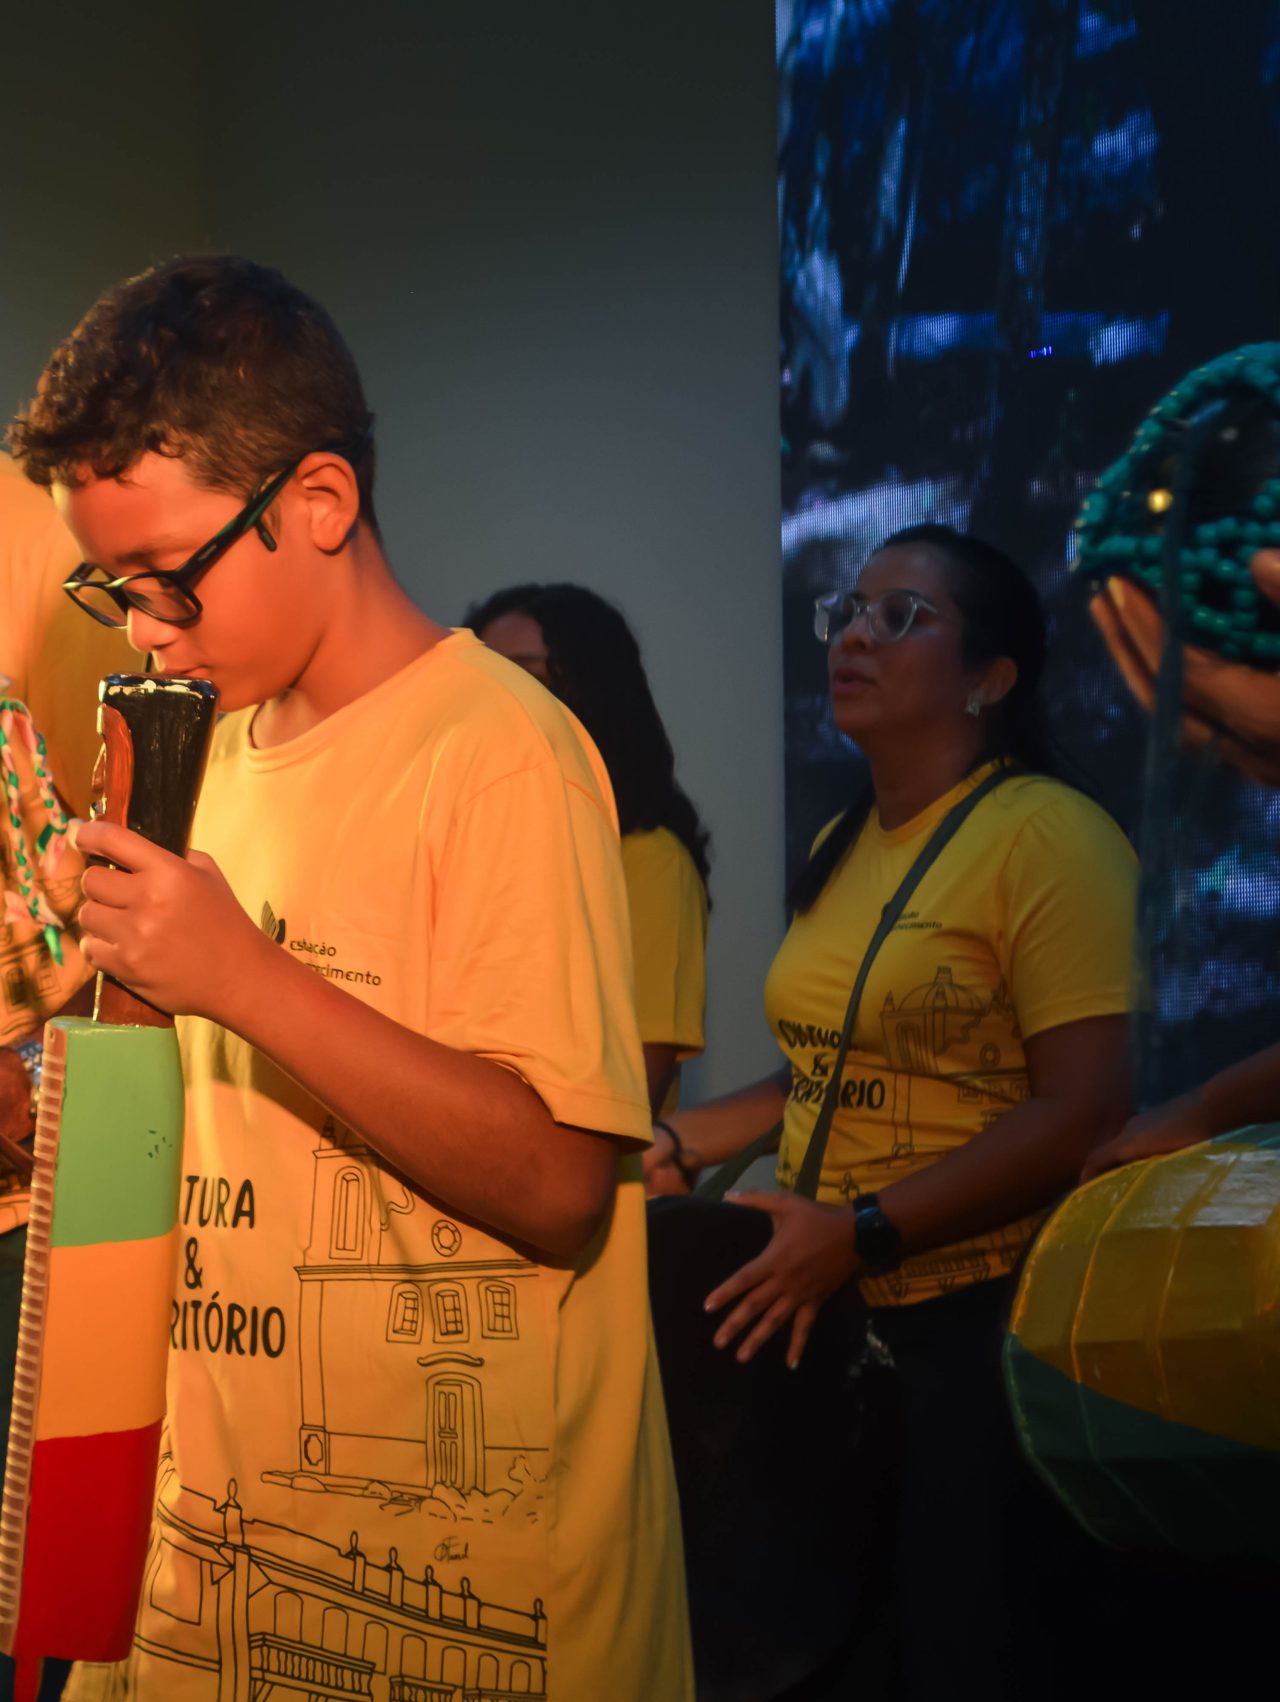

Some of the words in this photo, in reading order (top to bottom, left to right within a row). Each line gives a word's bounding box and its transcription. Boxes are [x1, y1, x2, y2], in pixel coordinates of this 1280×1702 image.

[184, 1175, 255, 1229] TURA
[185, 1236, 202, 1290] &
[171, 1291, 286, 1359] RITÓRIO
